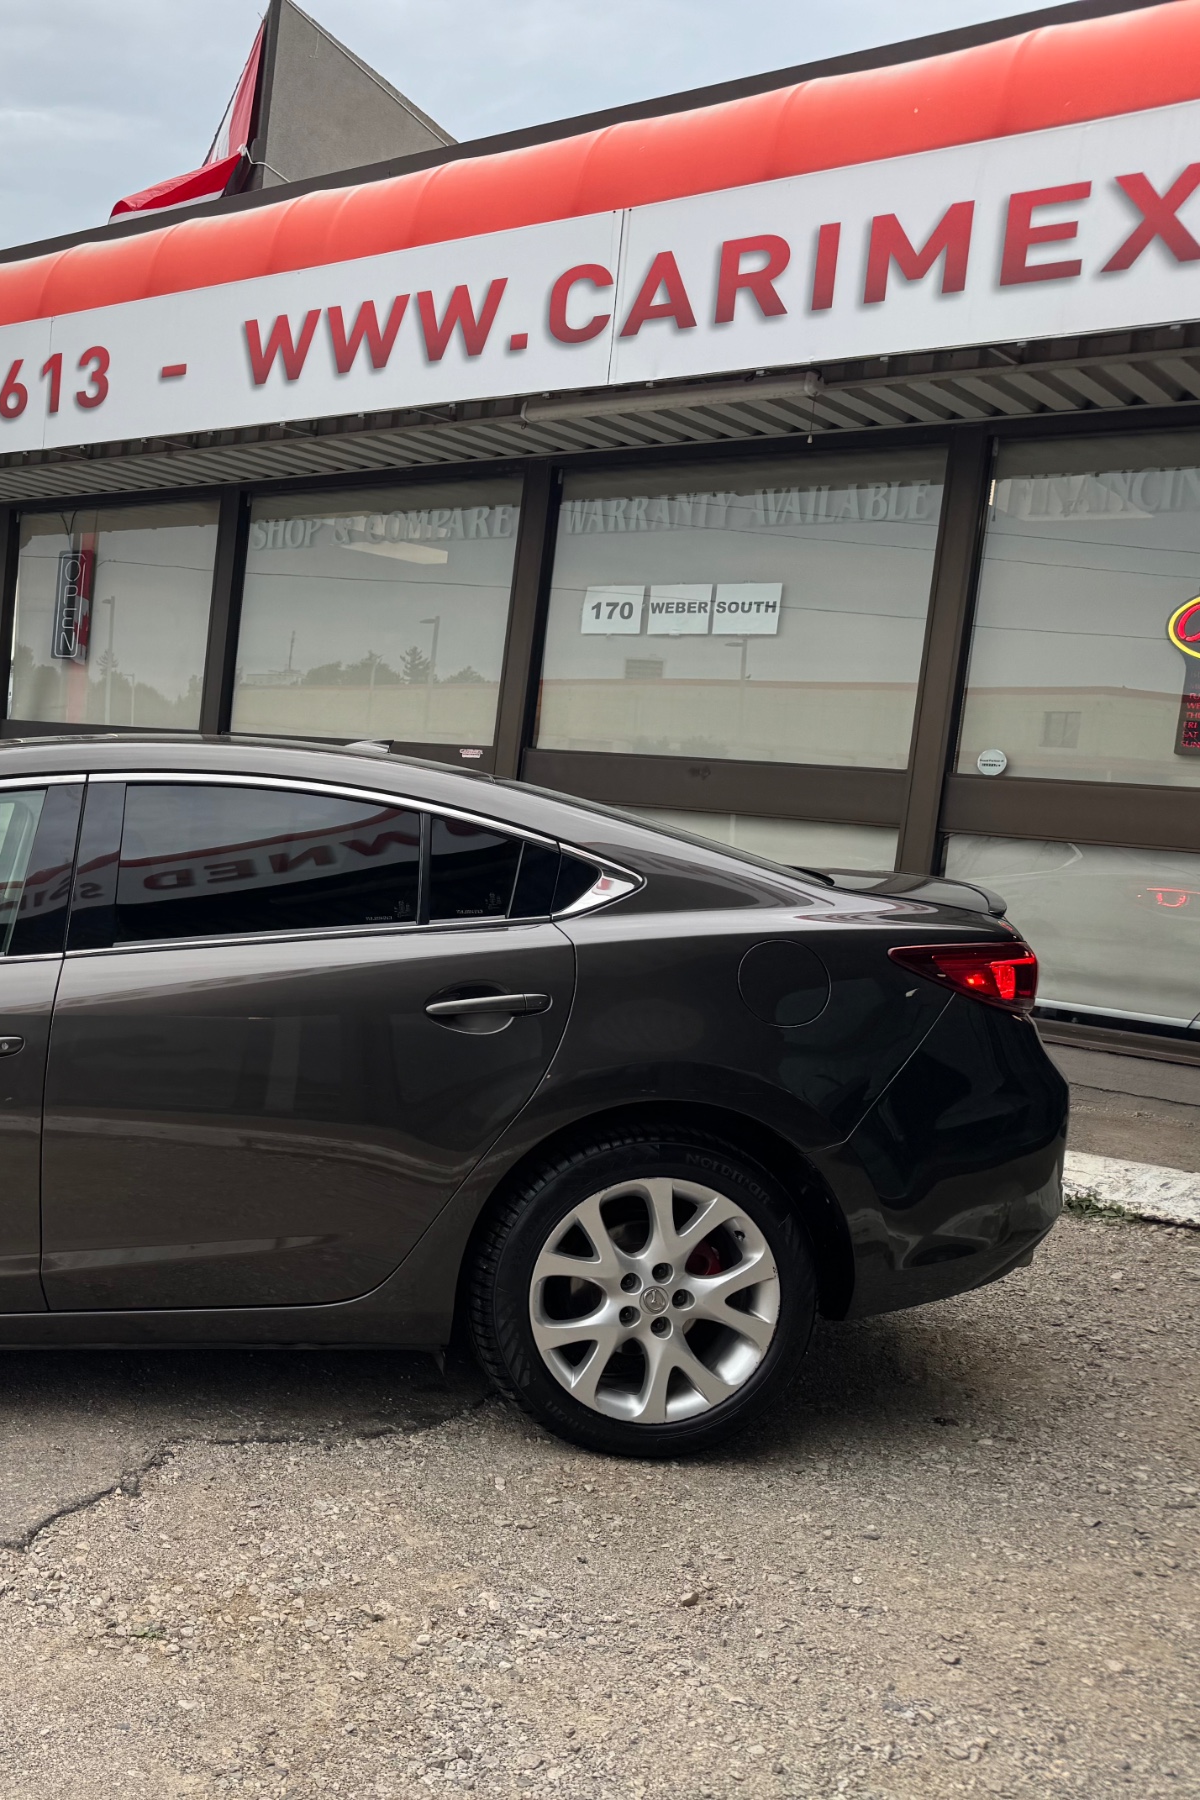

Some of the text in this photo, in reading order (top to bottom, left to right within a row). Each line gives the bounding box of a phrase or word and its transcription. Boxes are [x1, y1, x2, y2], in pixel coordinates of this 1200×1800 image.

[251, 518, 322, 550] SHOP
[363, 504, 515, 544] COMPARE
[566, 479, 932, 534] WARRANTY AVAILABLE
[59, 559, 81, 652] OPEN
[591, 601, 777, 620] 170 WEBER SOUTH
